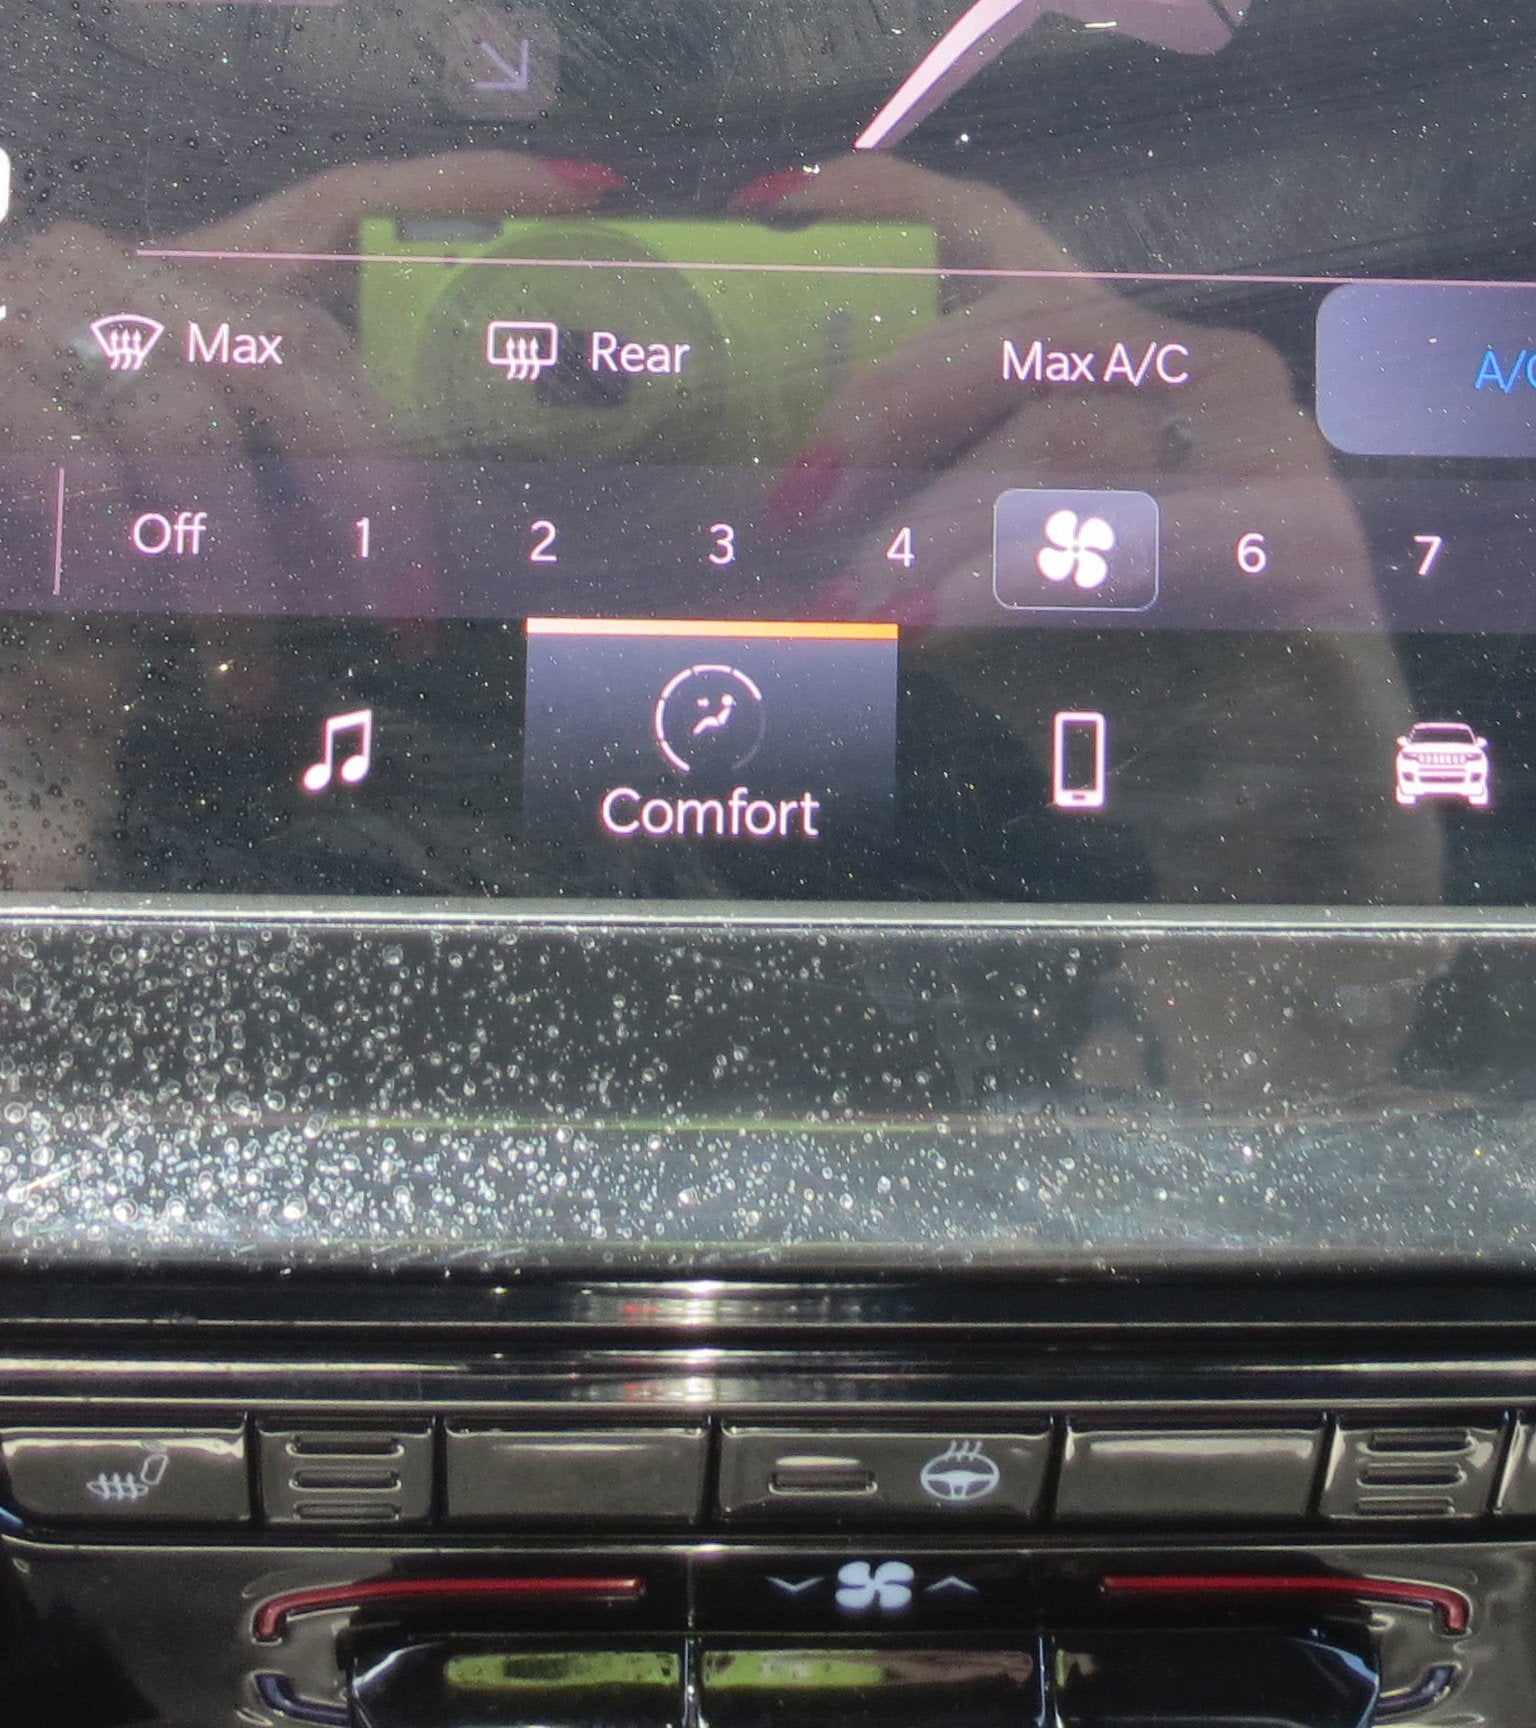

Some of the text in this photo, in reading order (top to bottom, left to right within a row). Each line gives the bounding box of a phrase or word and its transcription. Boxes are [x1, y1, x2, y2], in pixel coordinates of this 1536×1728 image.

[187, 322, 283, 365] Max
[589, 332, 690, 373] Rear
[1002, 340, 1189, 387] Max A/C
[132, 511, 207, 555] Off
[355, 518, 370, 558] 1
[529, 519, 558, 562] 2
[708, 523, 736, 565] 3
[886, 526, 916, 567] 4
[1236, 532, 1267, 574] 6
[1413, 535, 1443, 576] 7
[600, 786, 821, 837] Comfort
